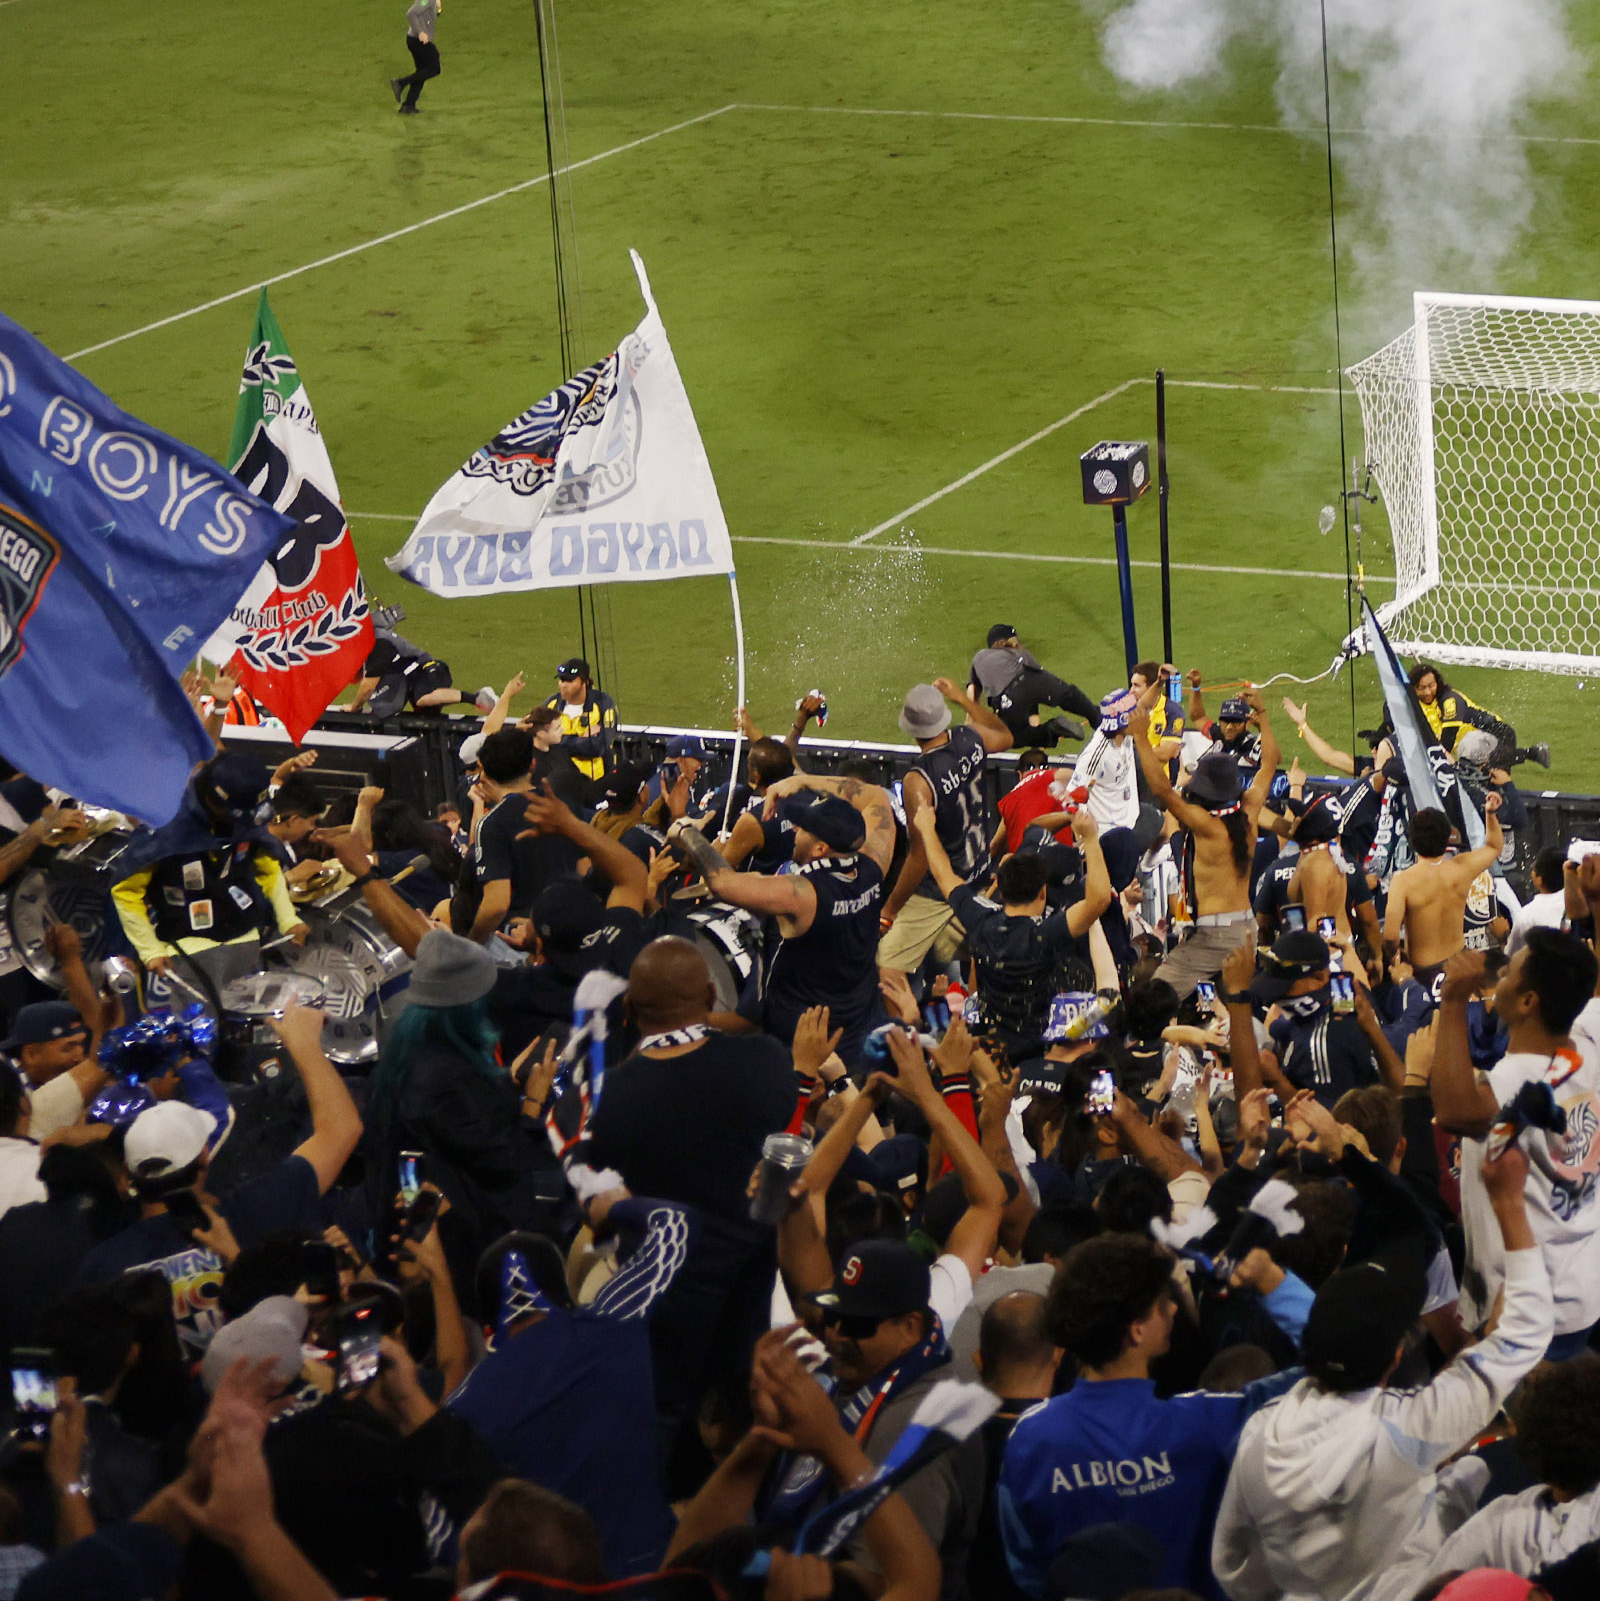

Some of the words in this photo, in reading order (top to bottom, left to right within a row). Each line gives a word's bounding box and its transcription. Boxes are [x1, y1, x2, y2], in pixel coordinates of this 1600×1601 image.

[39, 395, 259, 556] BOYS
[1051, 1450, 1172, 1494] ALBION
[1116, 1486, 1137, 1498] SAN
[1138, 1473, 1176, 1494] DIEGO
